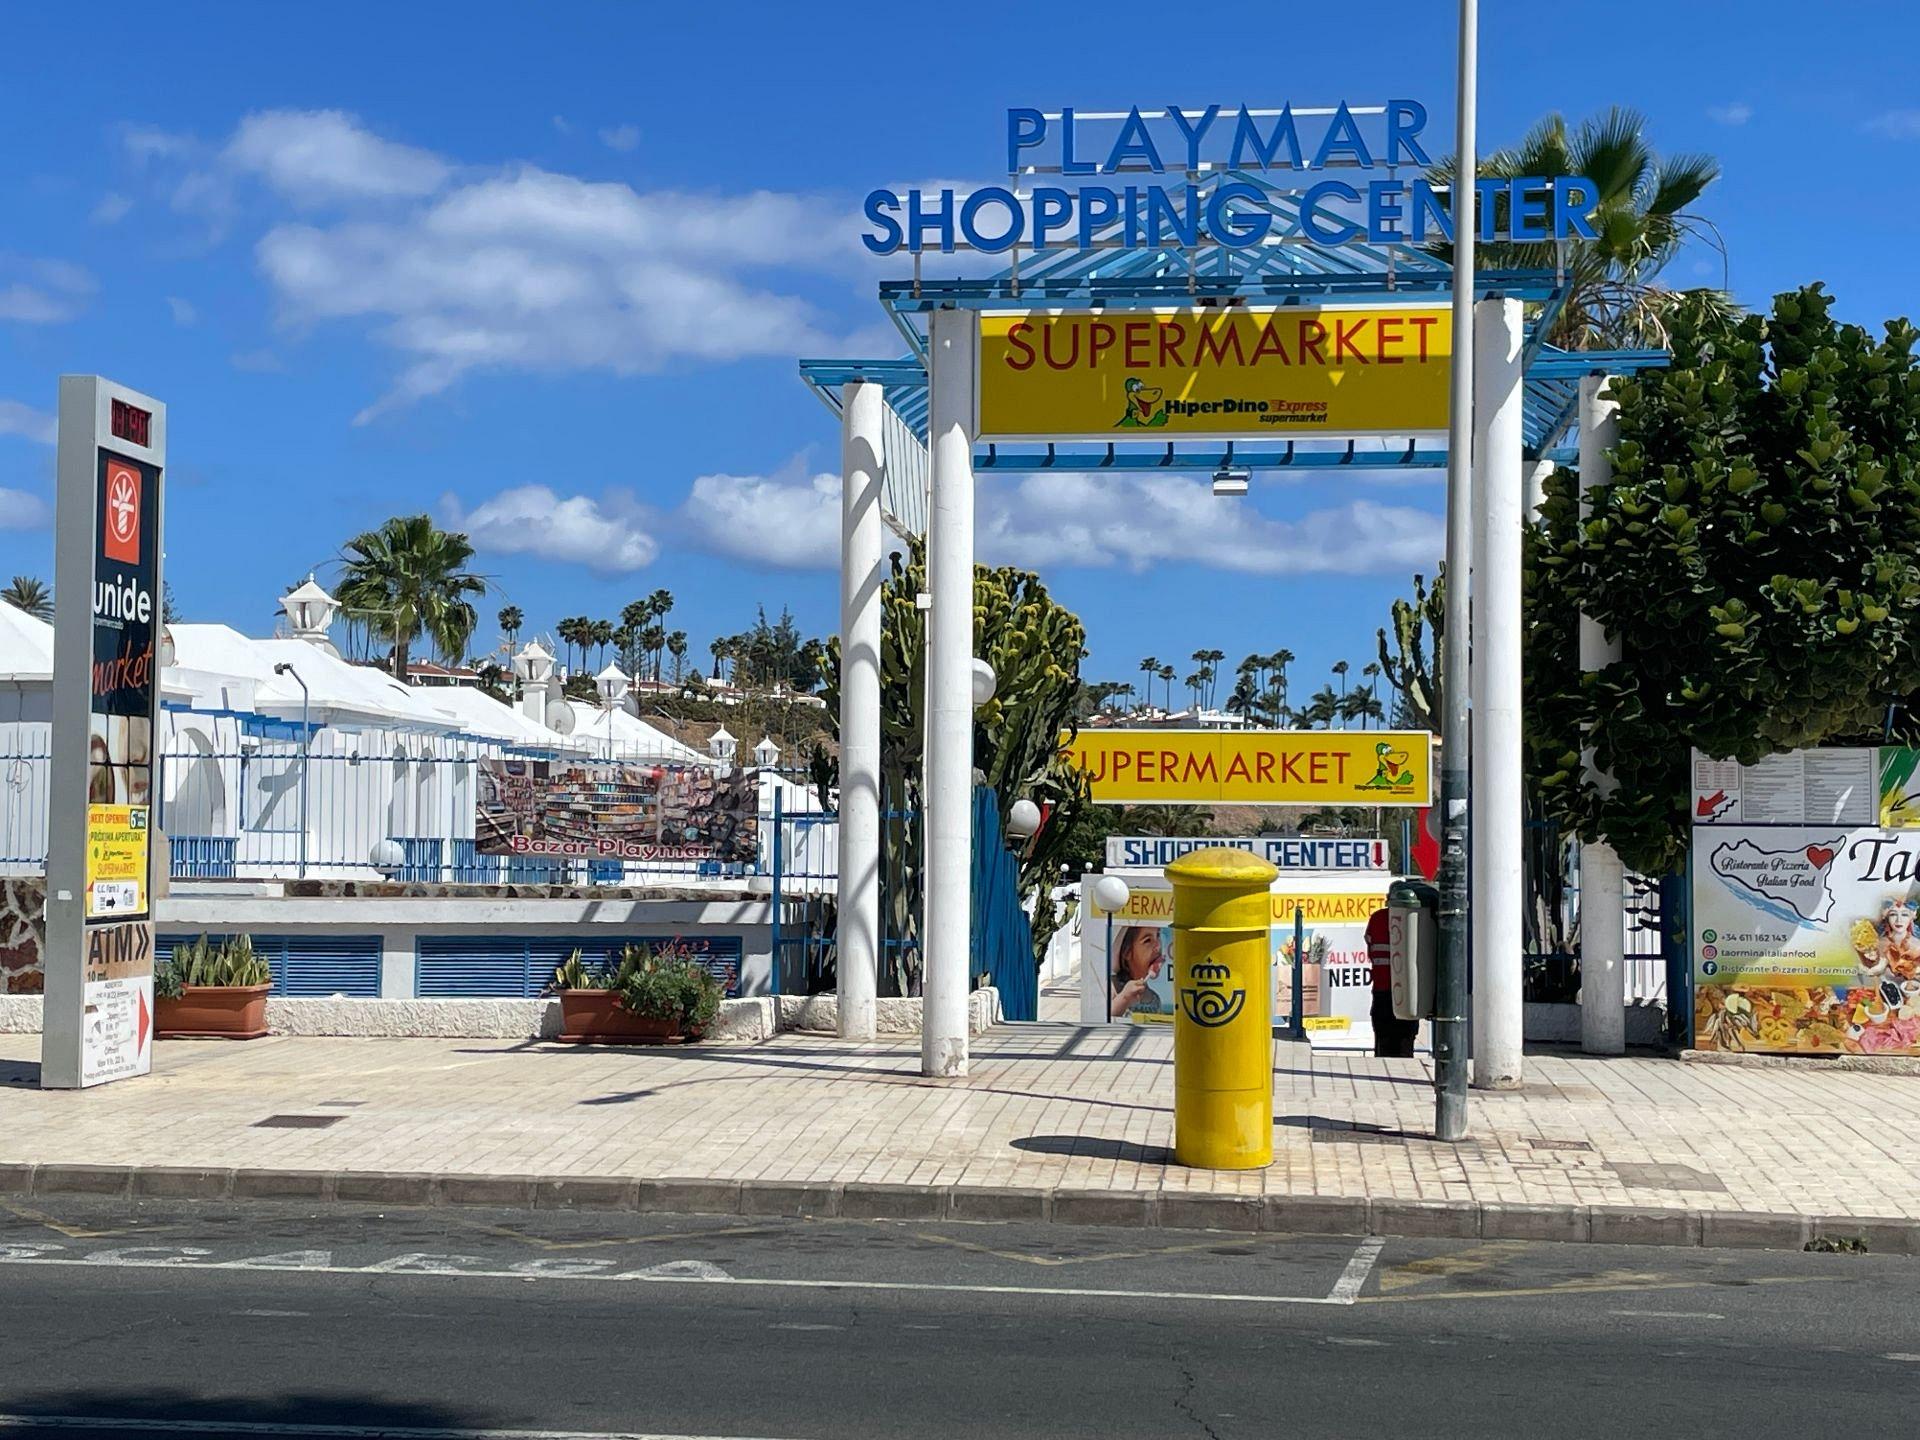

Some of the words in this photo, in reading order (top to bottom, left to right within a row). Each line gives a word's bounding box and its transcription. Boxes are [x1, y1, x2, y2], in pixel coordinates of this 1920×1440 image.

[1007, 99, 1432, 176] PLAYMAR
[861, 182, 1272, 256] SHOPPING
[1301, 175, 1601, 246] CENTER
[1005, 316, 1438, 371] SUPERMARKET
[1165, 399, 1269, 416] HiperDino
[1276, 399, 1328, 412] Express
[1259, 412, 1328, 424] supermarket
[94, 574, 151, 624] unide
[93, 639, 153, 696] market
[512, 835, 589, 854] Bazar
[597, 839, 714, 859] Playmar
[1125, 840, 1252, 865] SHOP
[1265, 841, 1370, 867] CENTER
[1721, 857, 1769, 871] Ristorante
[1771, 857, 1810, 871] Pizzeria
[1756, 874, 1788, 888] Italian
[1790, 874, 1815, 888] Food
[1272, 898, 1385, 918] UPERMARKET
[1739, 934, 1752, 942] 611
[1772, 934, 1788, 942] 143
[1329, 952, 1349, 964] ALL
[1352, 951, 1372, 964] YO
[1329, 967, 1373, 988] NEED
[1721, 966, 1770, 974] Ristorante
[1772, 966, 1809, 974] Pizzeria
